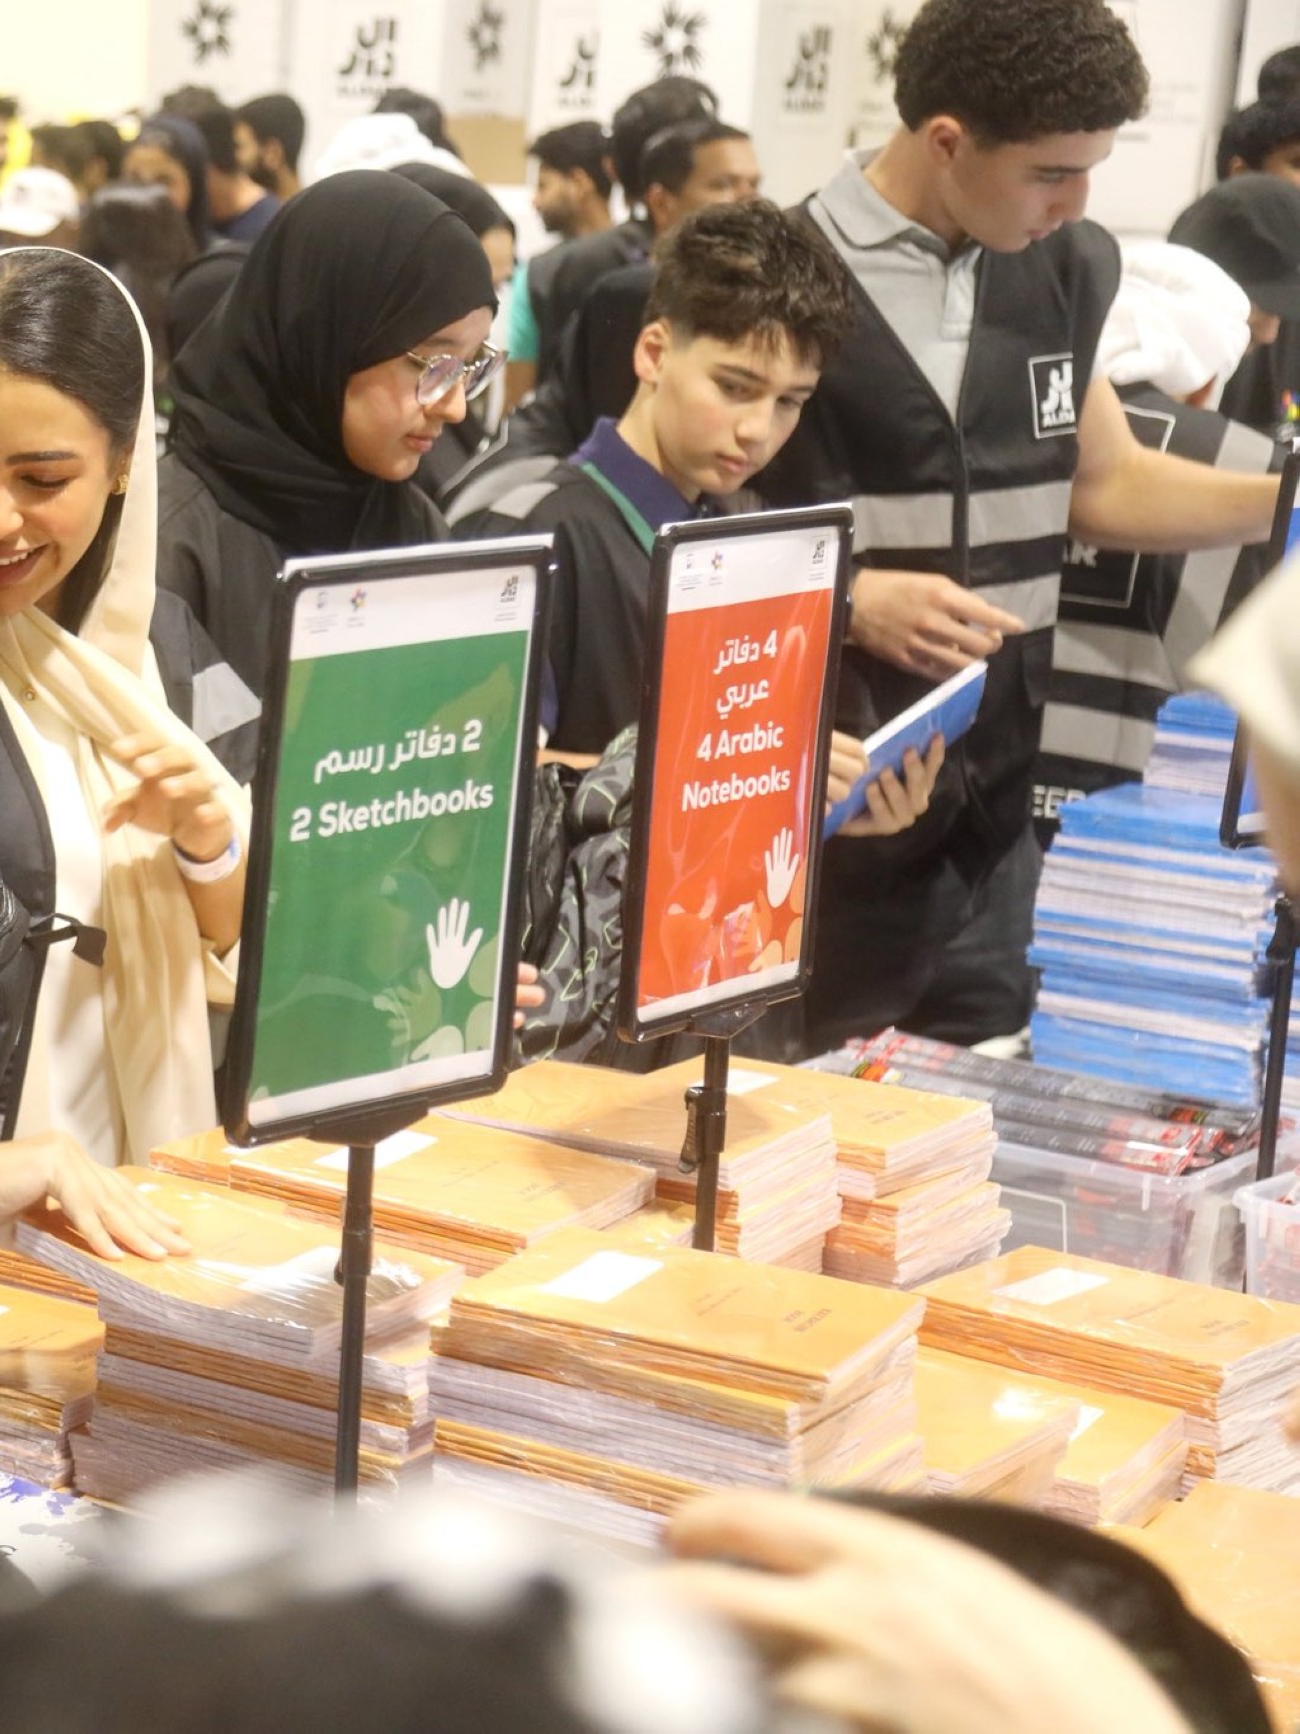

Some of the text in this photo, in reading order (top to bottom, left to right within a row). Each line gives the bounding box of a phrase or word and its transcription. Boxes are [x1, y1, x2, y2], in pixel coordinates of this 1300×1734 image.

[713, 630, 778, 675] 4 دفاتر
[716, 679, 769, 720] عربي
[313, 719, 482, 784] 2 دفاتر رسم
[696, 721, 784, 762] 4 Arabic
[289, 779, 494, 842] 2 Sketchbooks
[681, 765, 791, 812] Notebooks
